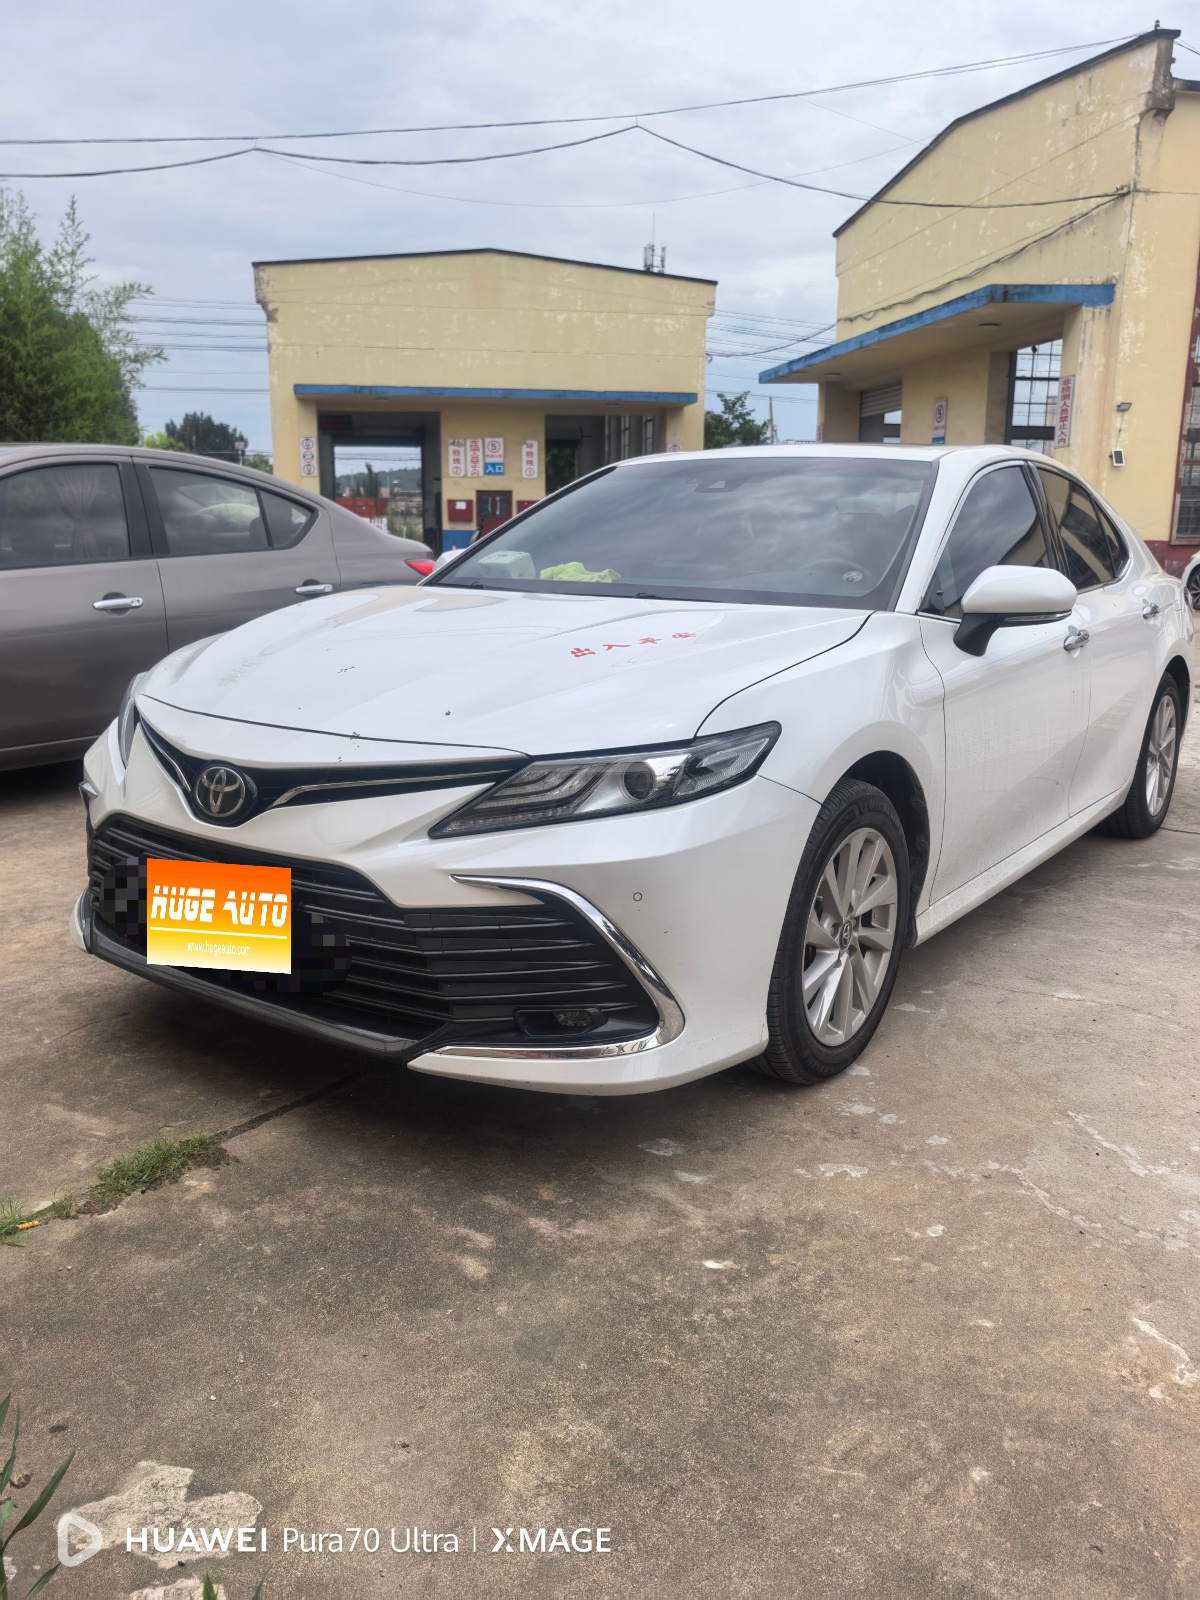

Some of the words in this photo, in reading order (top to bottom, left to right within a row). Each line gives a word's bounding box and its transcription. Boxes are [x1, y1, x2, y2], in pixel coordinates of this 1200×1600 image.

[1057, 378, 1072, 445] 非检测人员禁止入内
[486, 464, 503, 473] 入口
